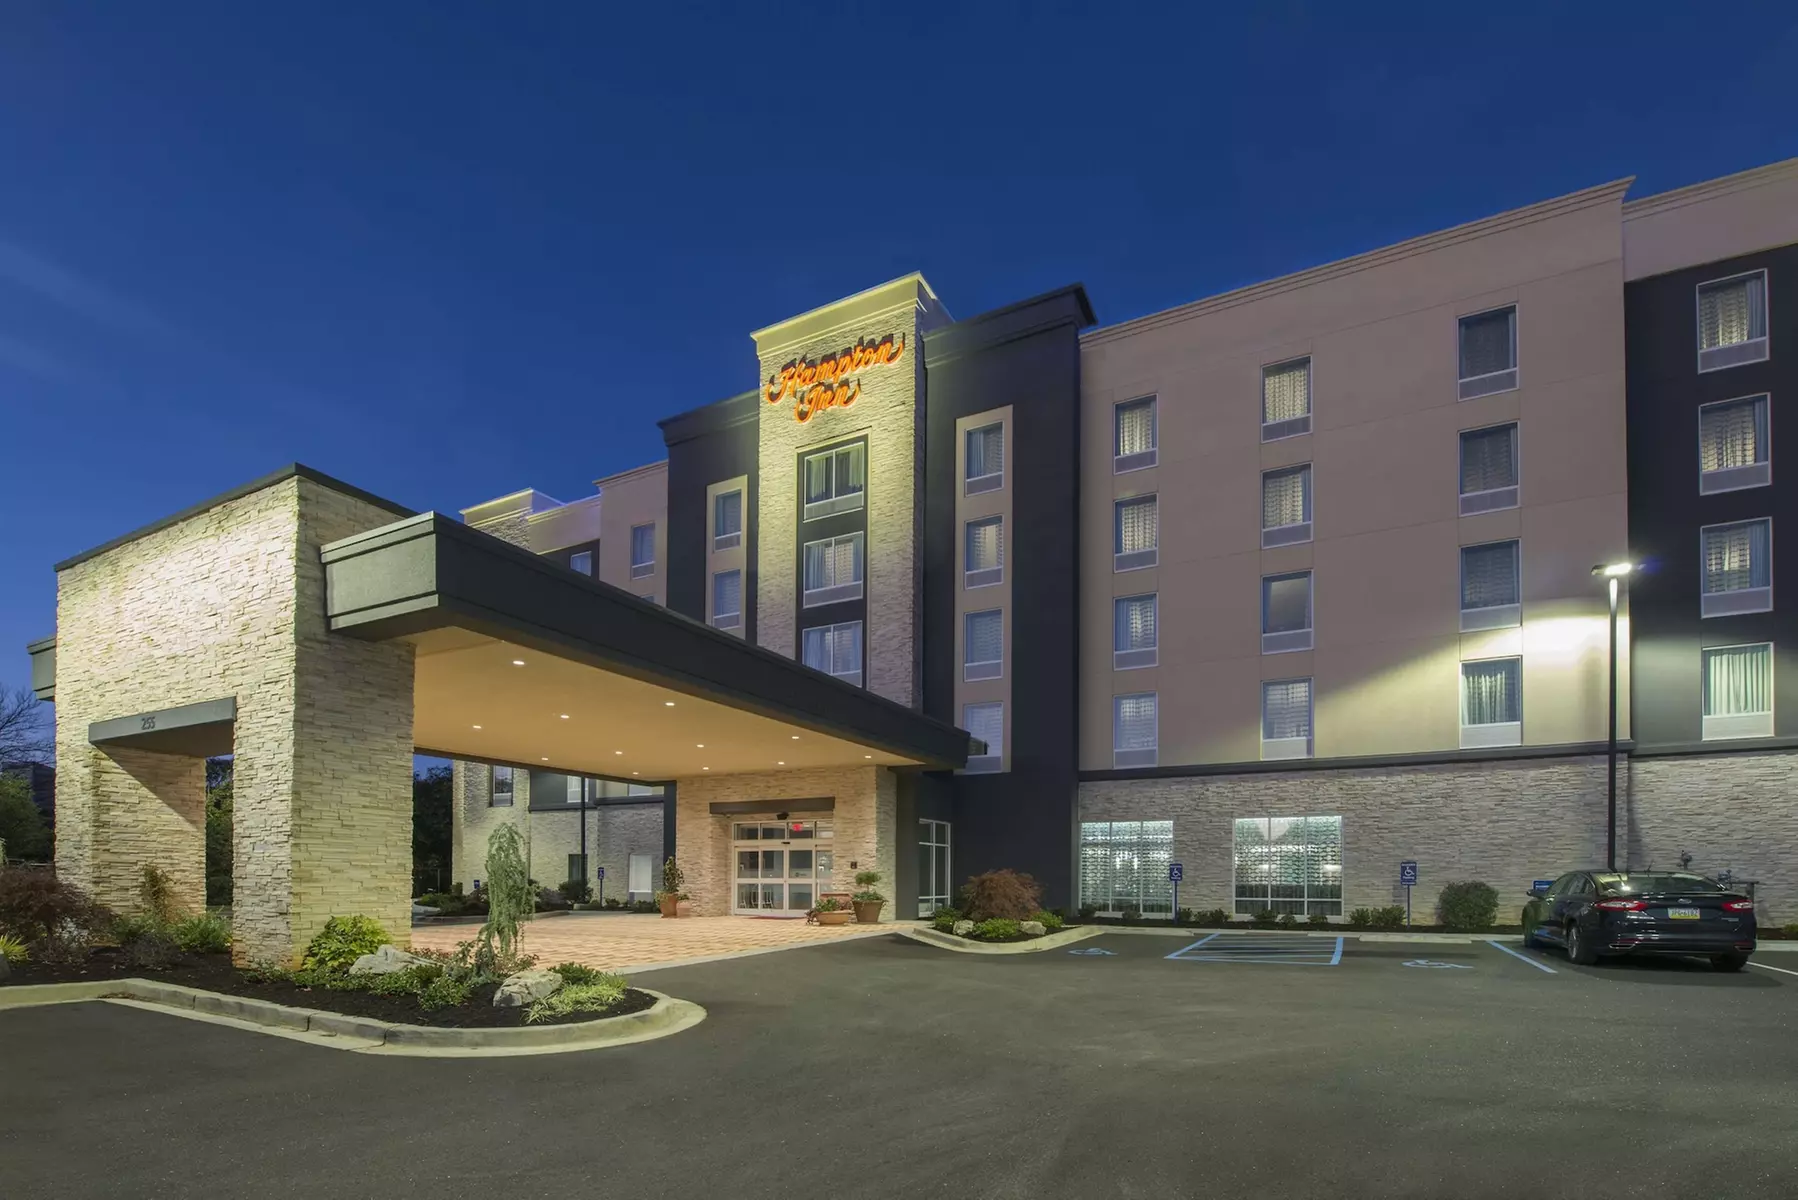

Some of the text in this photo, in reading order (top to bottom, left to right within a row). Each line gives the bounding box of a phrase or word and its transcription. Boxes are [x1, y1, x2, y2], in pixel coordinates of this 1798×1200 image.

[765, 335, 905, 404] Hampton
[794, 380, 861, 423] Inn
[141, 716, 155, 730] 255
